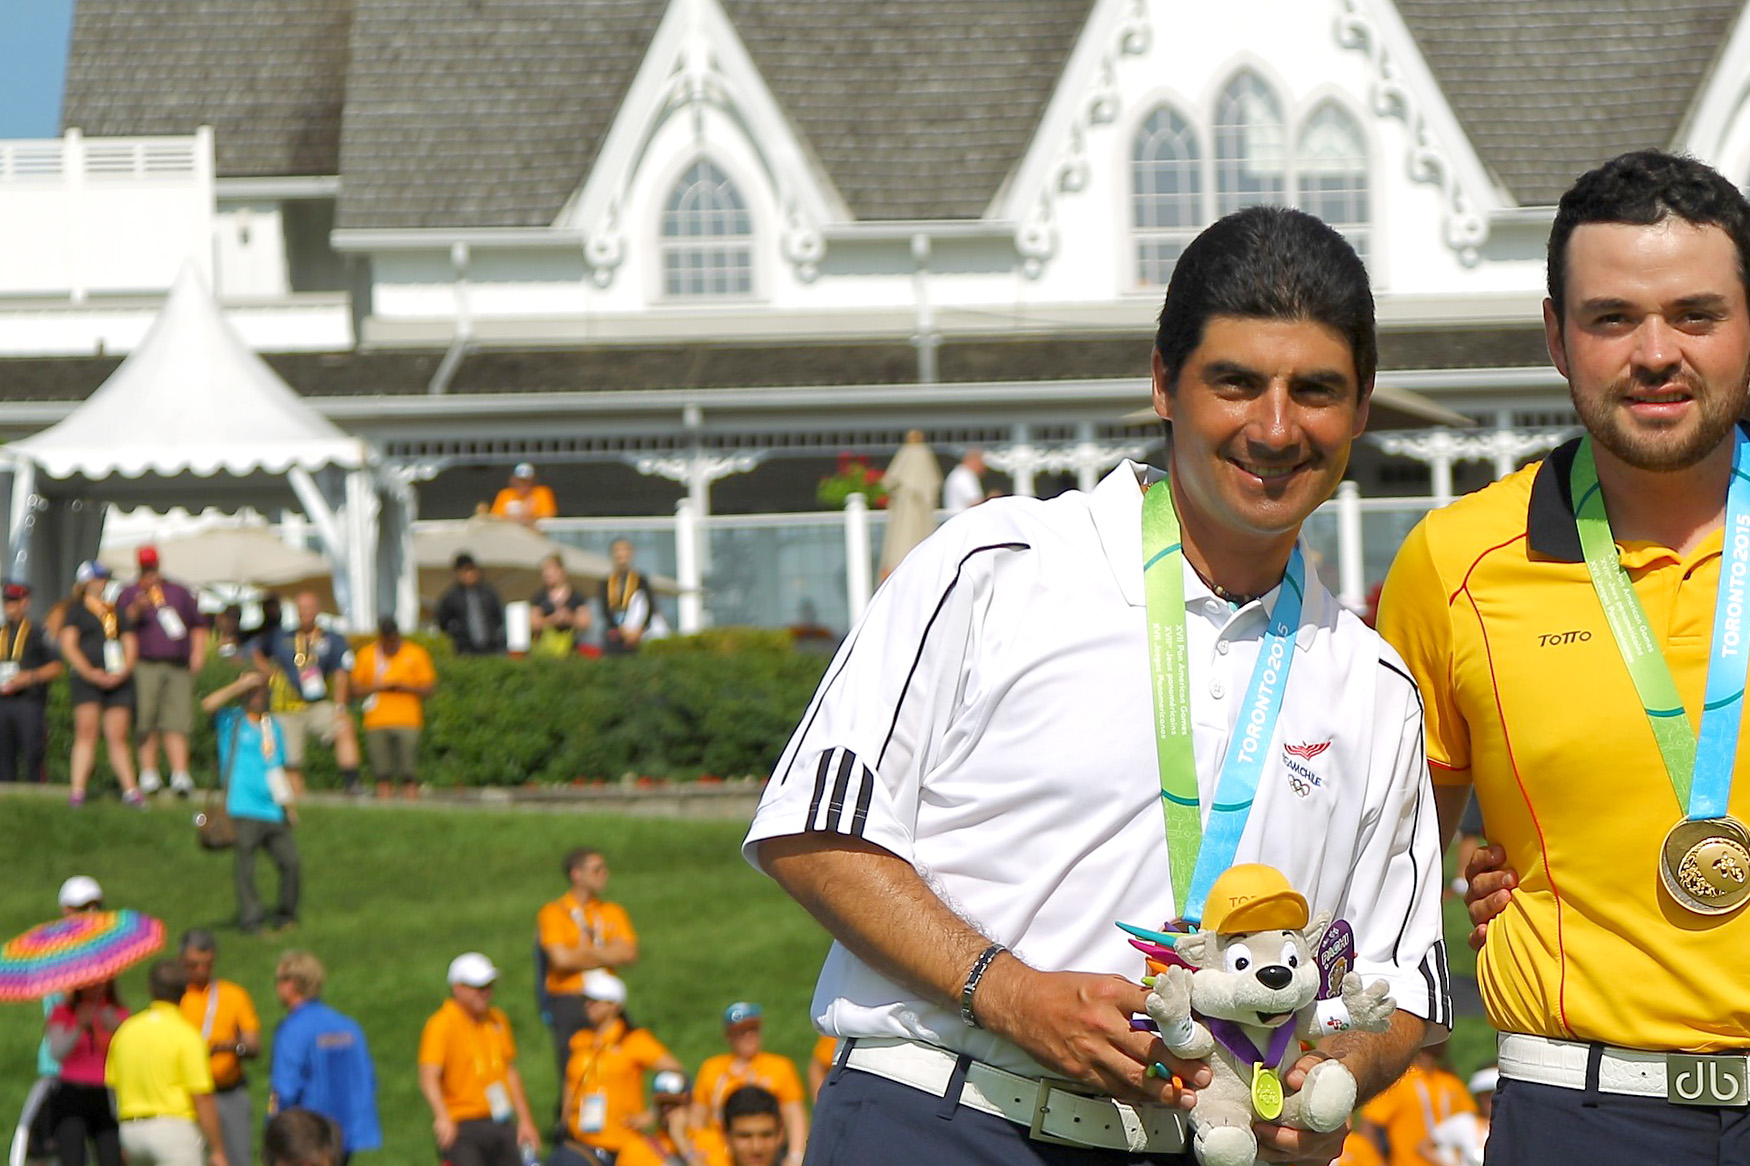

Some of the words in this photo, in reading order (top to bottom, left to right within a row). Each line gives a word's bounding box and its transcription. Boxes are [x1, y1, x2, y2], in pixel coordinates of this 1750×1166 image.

[1622, 586, 1643, 624] American
[1637, 624, 1655, 653] Games
[1176, 662, 1187, 703] American
[1179, 705, 1189, 735] Games
